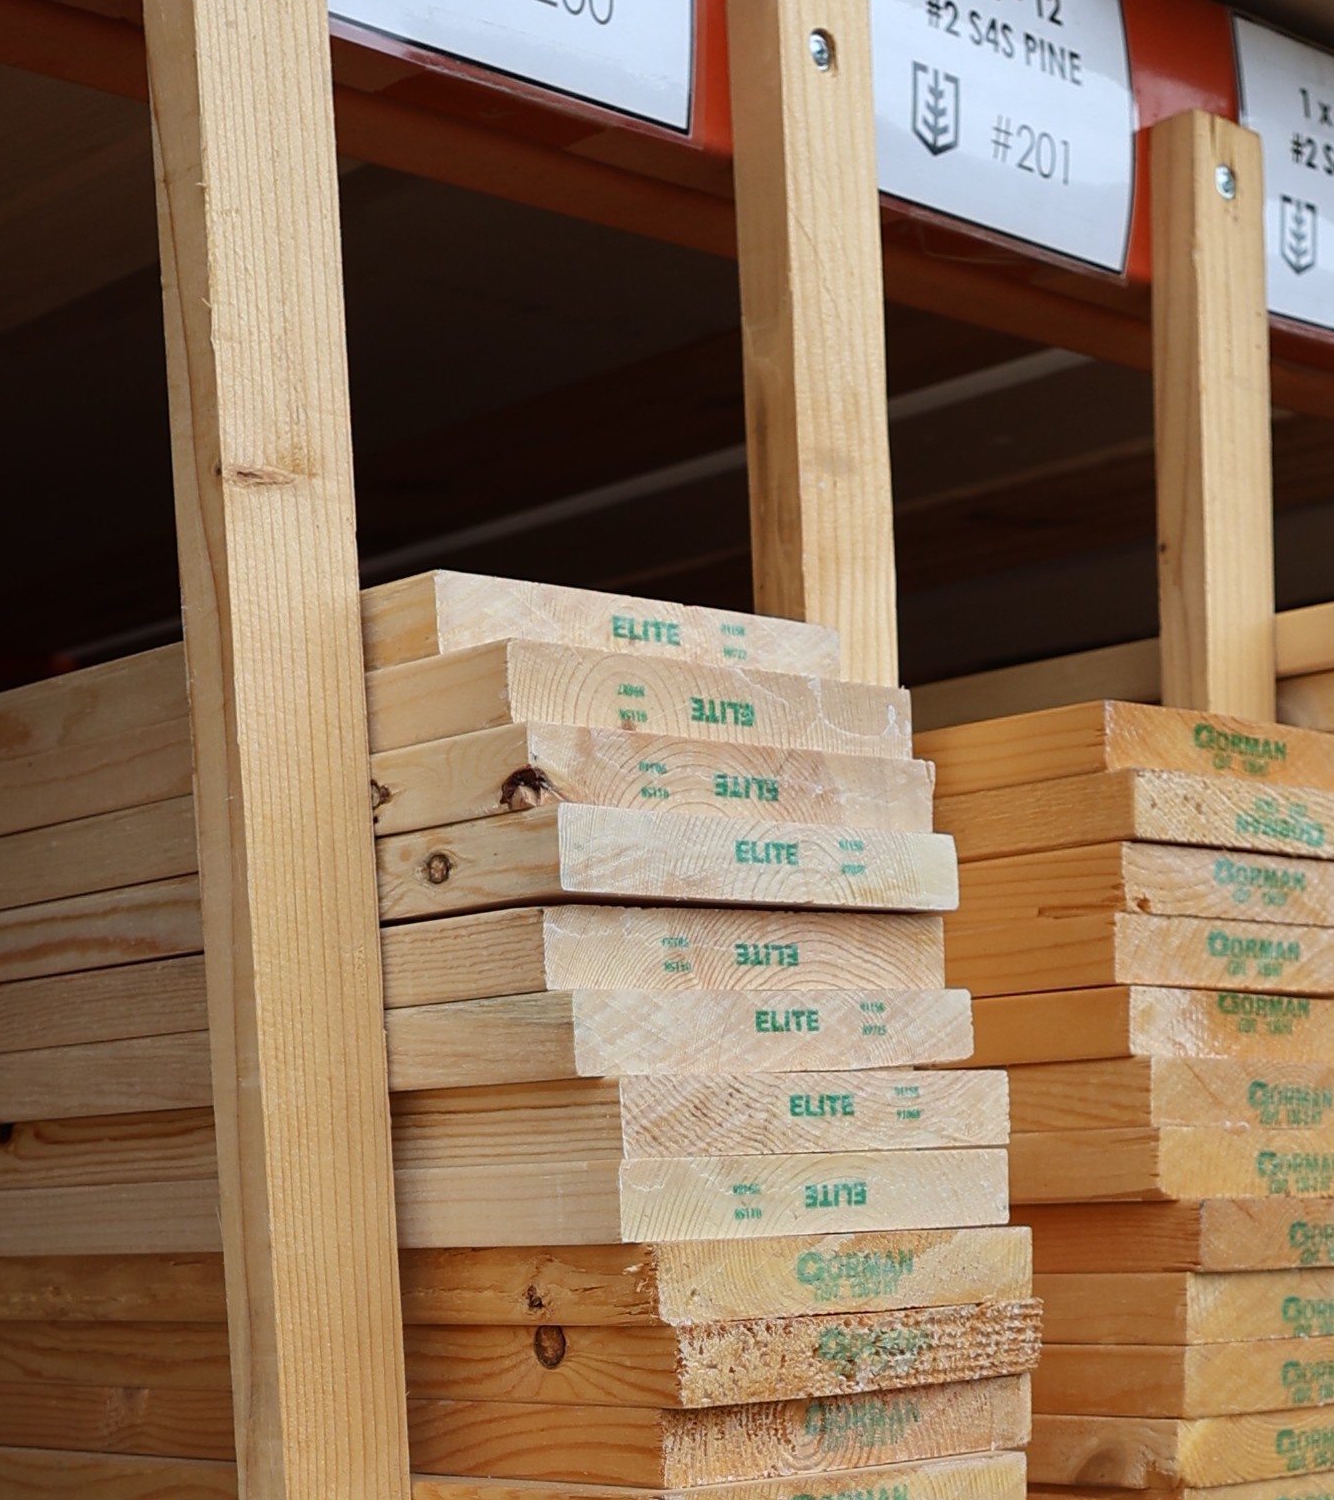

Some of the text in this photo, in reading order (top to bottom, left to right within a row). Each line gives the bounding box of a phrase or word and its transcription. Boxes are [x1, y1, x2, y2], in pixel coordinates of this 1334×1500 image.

[970, 11, 1014, 59] S4S
[1023, 33, 1083, 86] PINE
[1299, 87, 1311, 118] 1
[1317, 101, 1333, 126] x
[991, 114, 1071, 185] #201
[1290, 132, 1319, 170] #2
[611, 614, 681, 647] ELITE
[1192, 722, 1287, 762] GORMAN
[714, 773, 779, 802] ELITE
[734, 840, 799, 866] ELITE
[1212, 857, 1307, 892] GORMAN
[734, 943, 799, 967] ELITE
[1206, 930, 1301, 960] GORMAN
[754, 1008, 820, 1034] ELITE
[789, 1093, 855, 1118] ELITE
